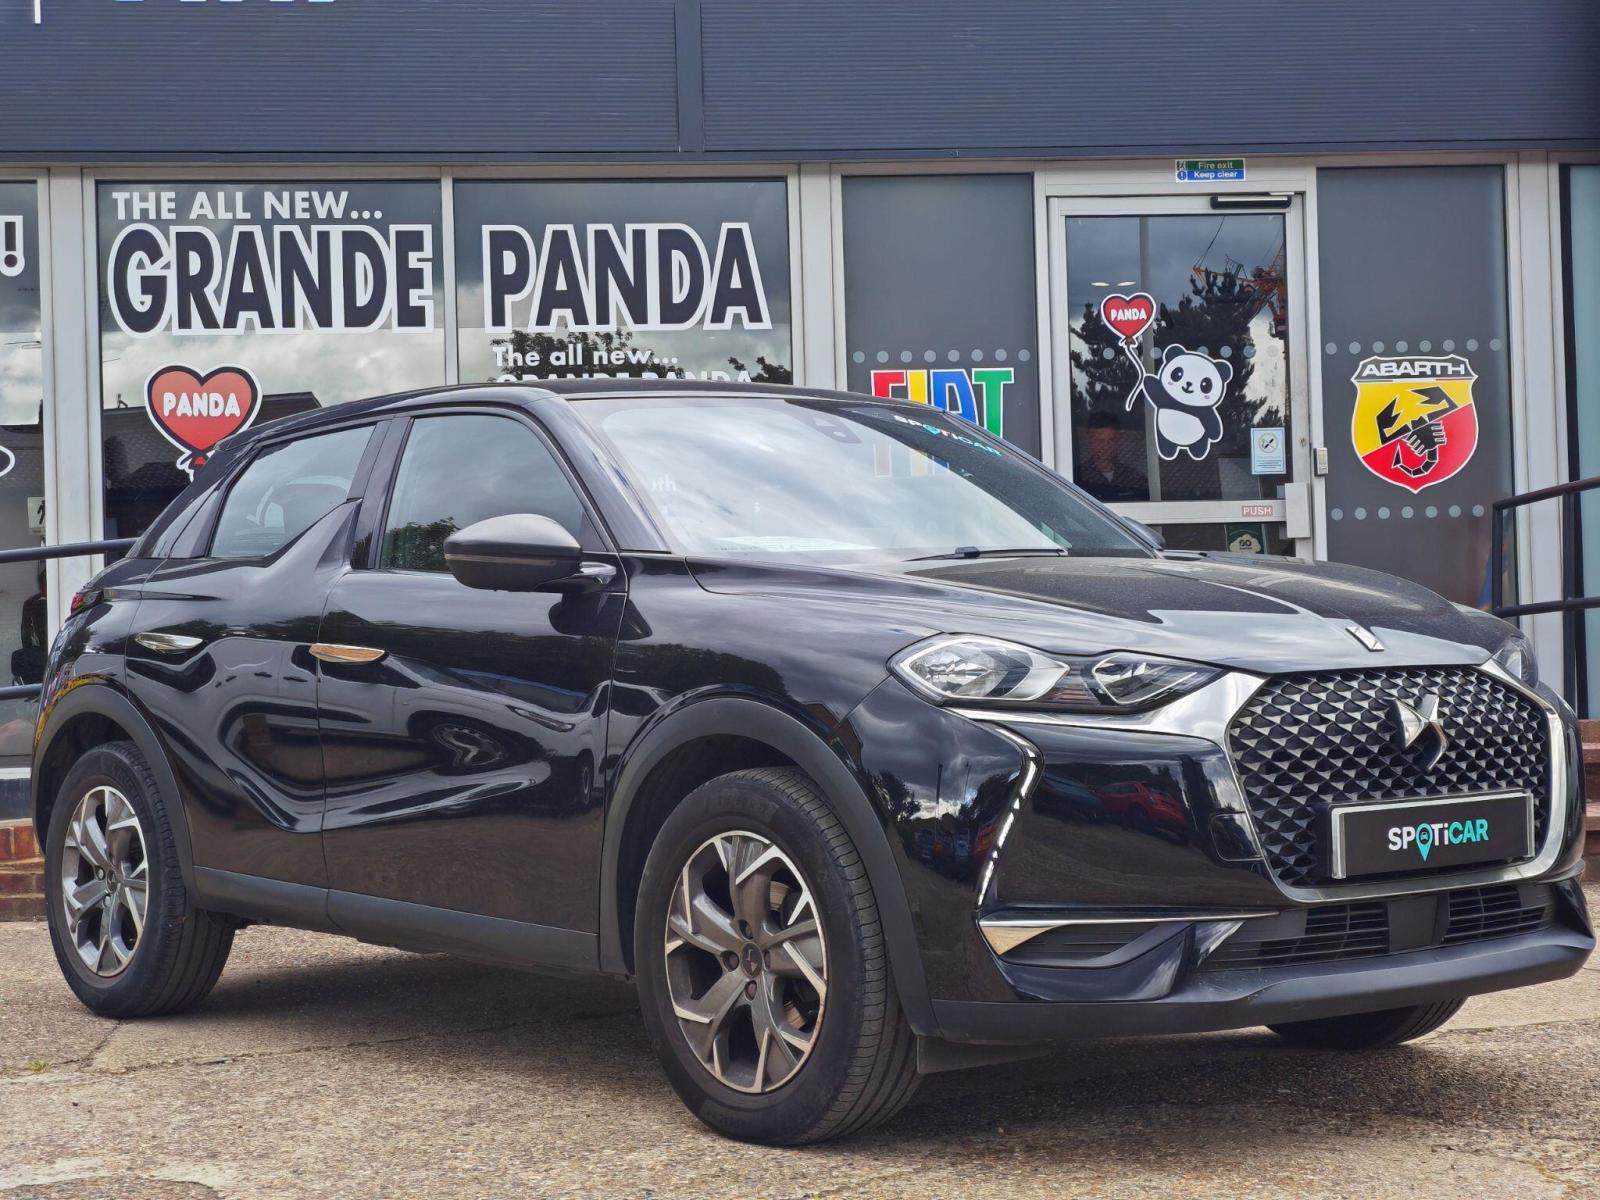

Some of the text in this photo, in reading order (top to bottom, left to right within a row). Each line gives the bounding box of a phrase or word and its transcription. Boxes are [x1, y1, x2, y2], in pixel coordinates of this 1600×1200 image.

[1198, 160, 1233, 169] Fire exit
[1194, 170, 1238, 180] Keep clear
[112, 190, 383, 220] THE ALL NEW...
[108, 222, 773, 338] GRANDE PANDA
[1110, 307, 1148, 321] PANDA
[492, 343, 678, 367] The all new...
[1361, 360, 1466, 377] ABARTH
[162, 391, 241, 417] PANDA
[1242, 506, 1272, 516] PUSH
